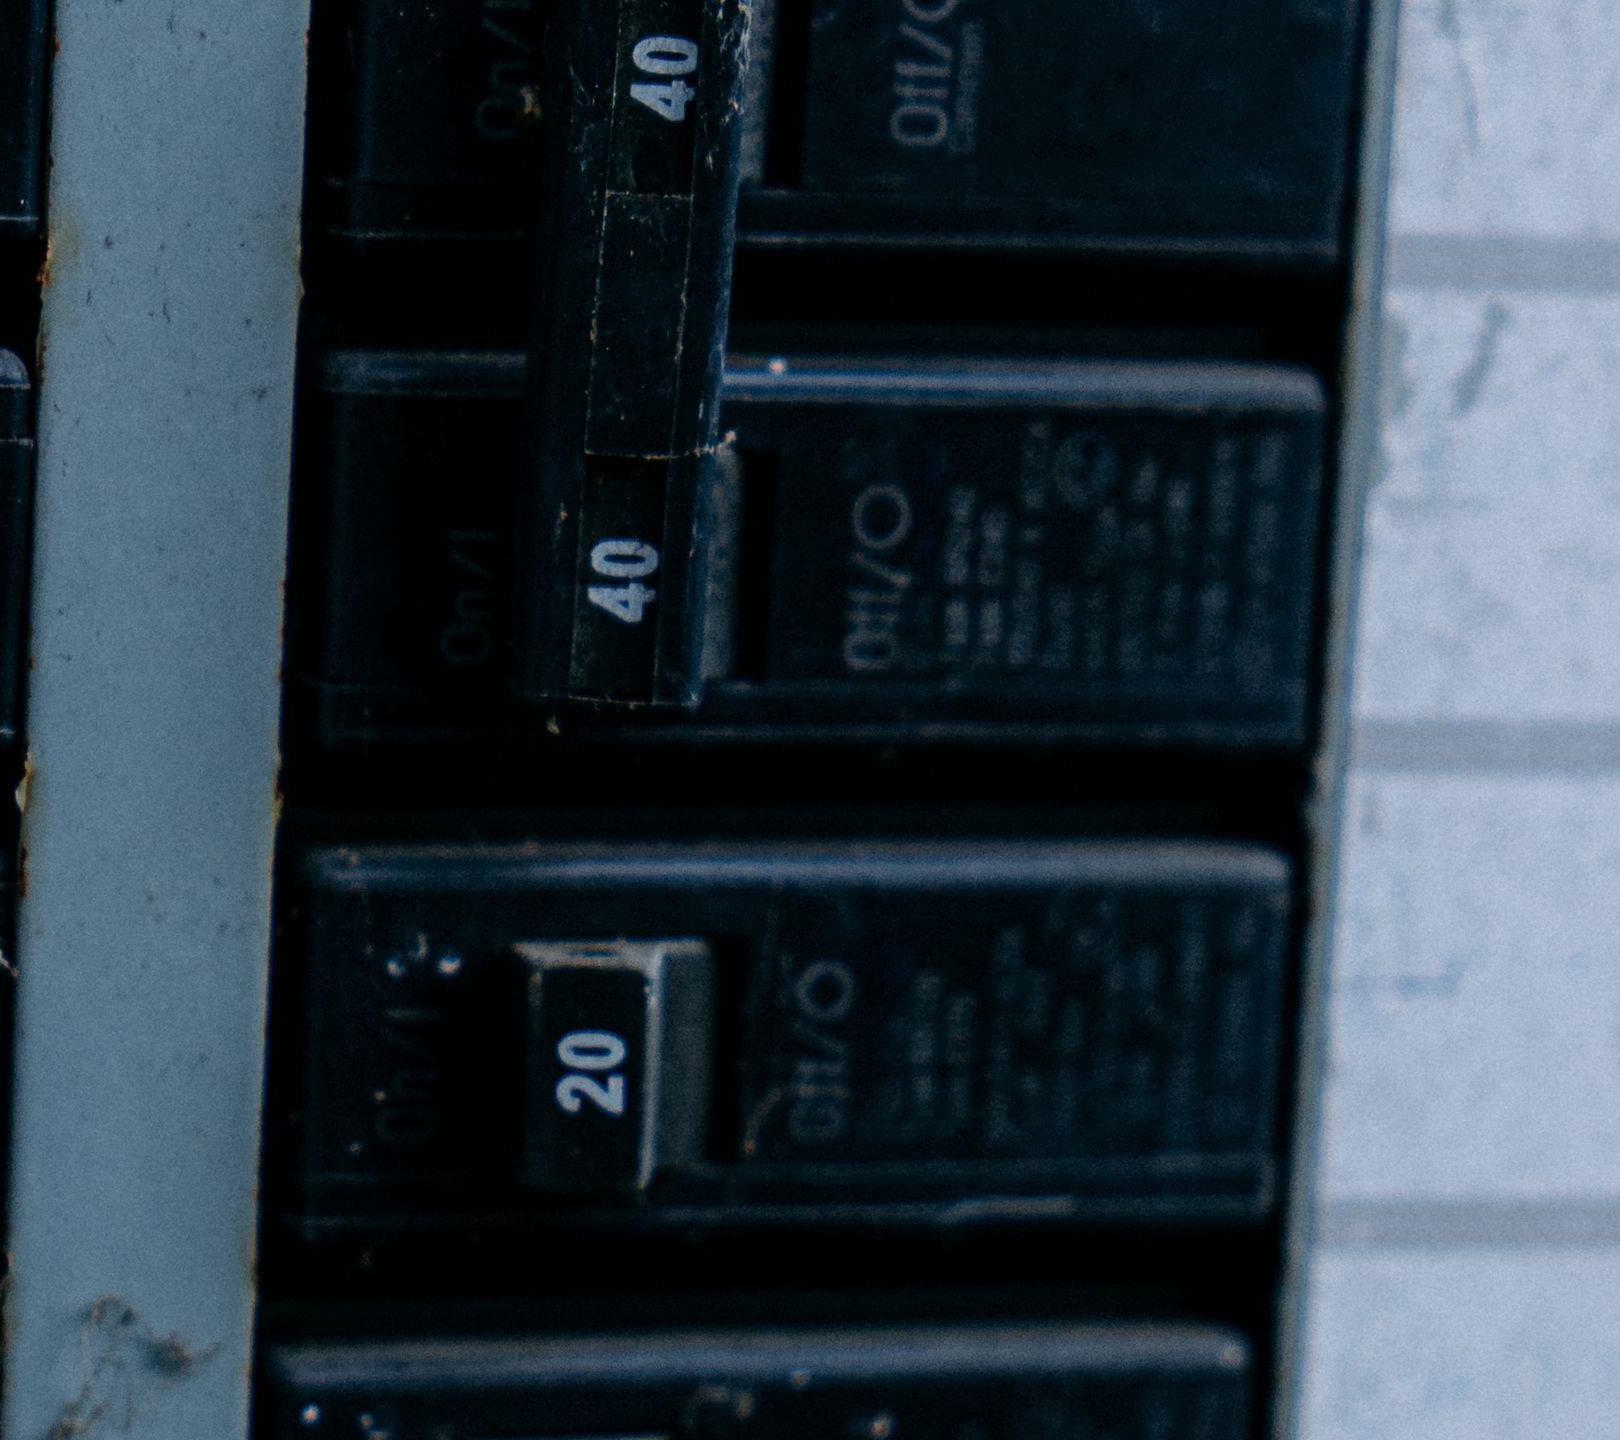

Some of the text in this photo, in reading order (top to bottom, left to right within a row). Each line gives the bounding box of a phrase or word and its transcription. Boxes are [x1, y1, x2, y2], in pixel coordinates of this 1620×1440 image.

[630, 34, 697, 125] 40
[585, 536, 661, 625] 40
[553, 1028, 628, 1117] 20
